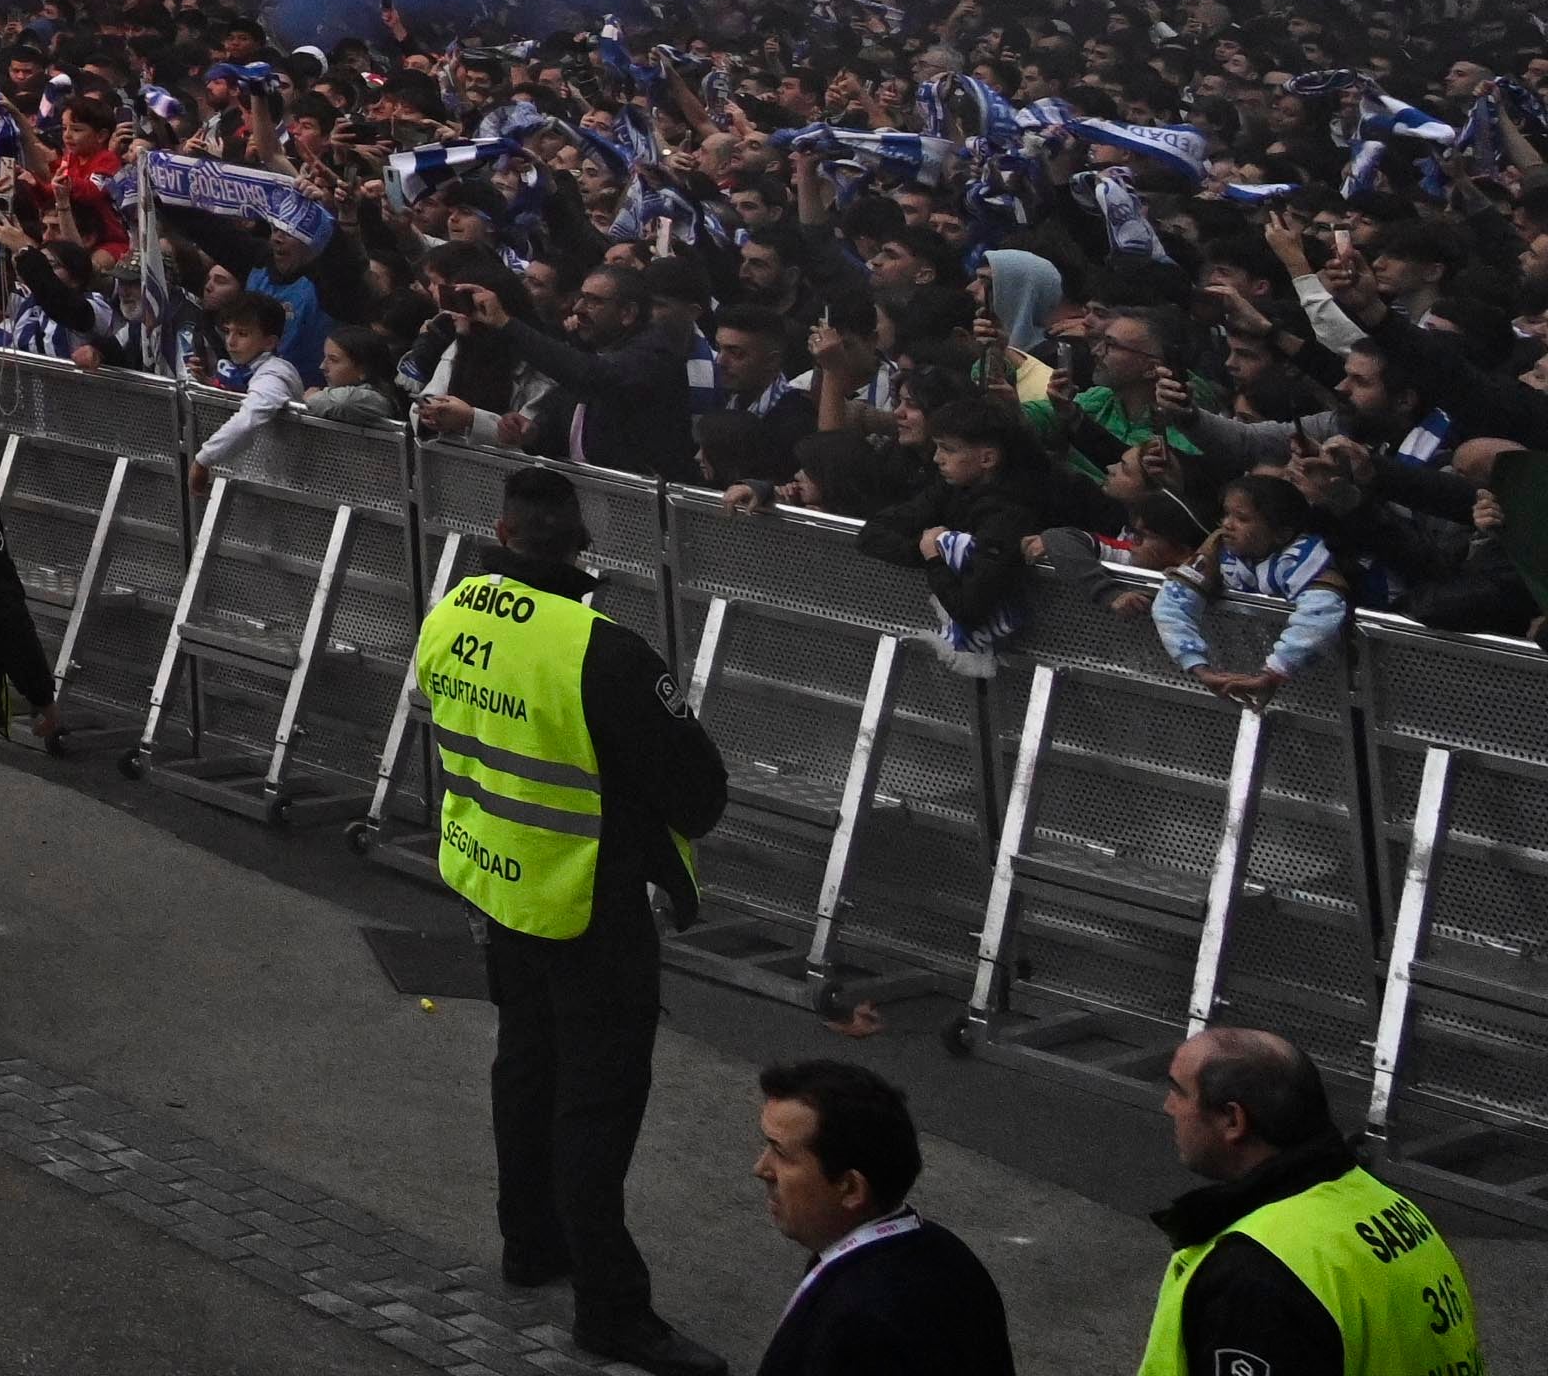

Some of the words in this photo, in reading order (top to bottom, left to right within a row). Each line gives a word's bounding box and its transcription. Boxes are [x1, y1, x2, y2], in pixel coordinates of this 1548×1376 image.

[453, 582, 536, 624] SABICO
[450, 632, 493, 671] 421
[1421, 1273, 1464, 1335] 316
